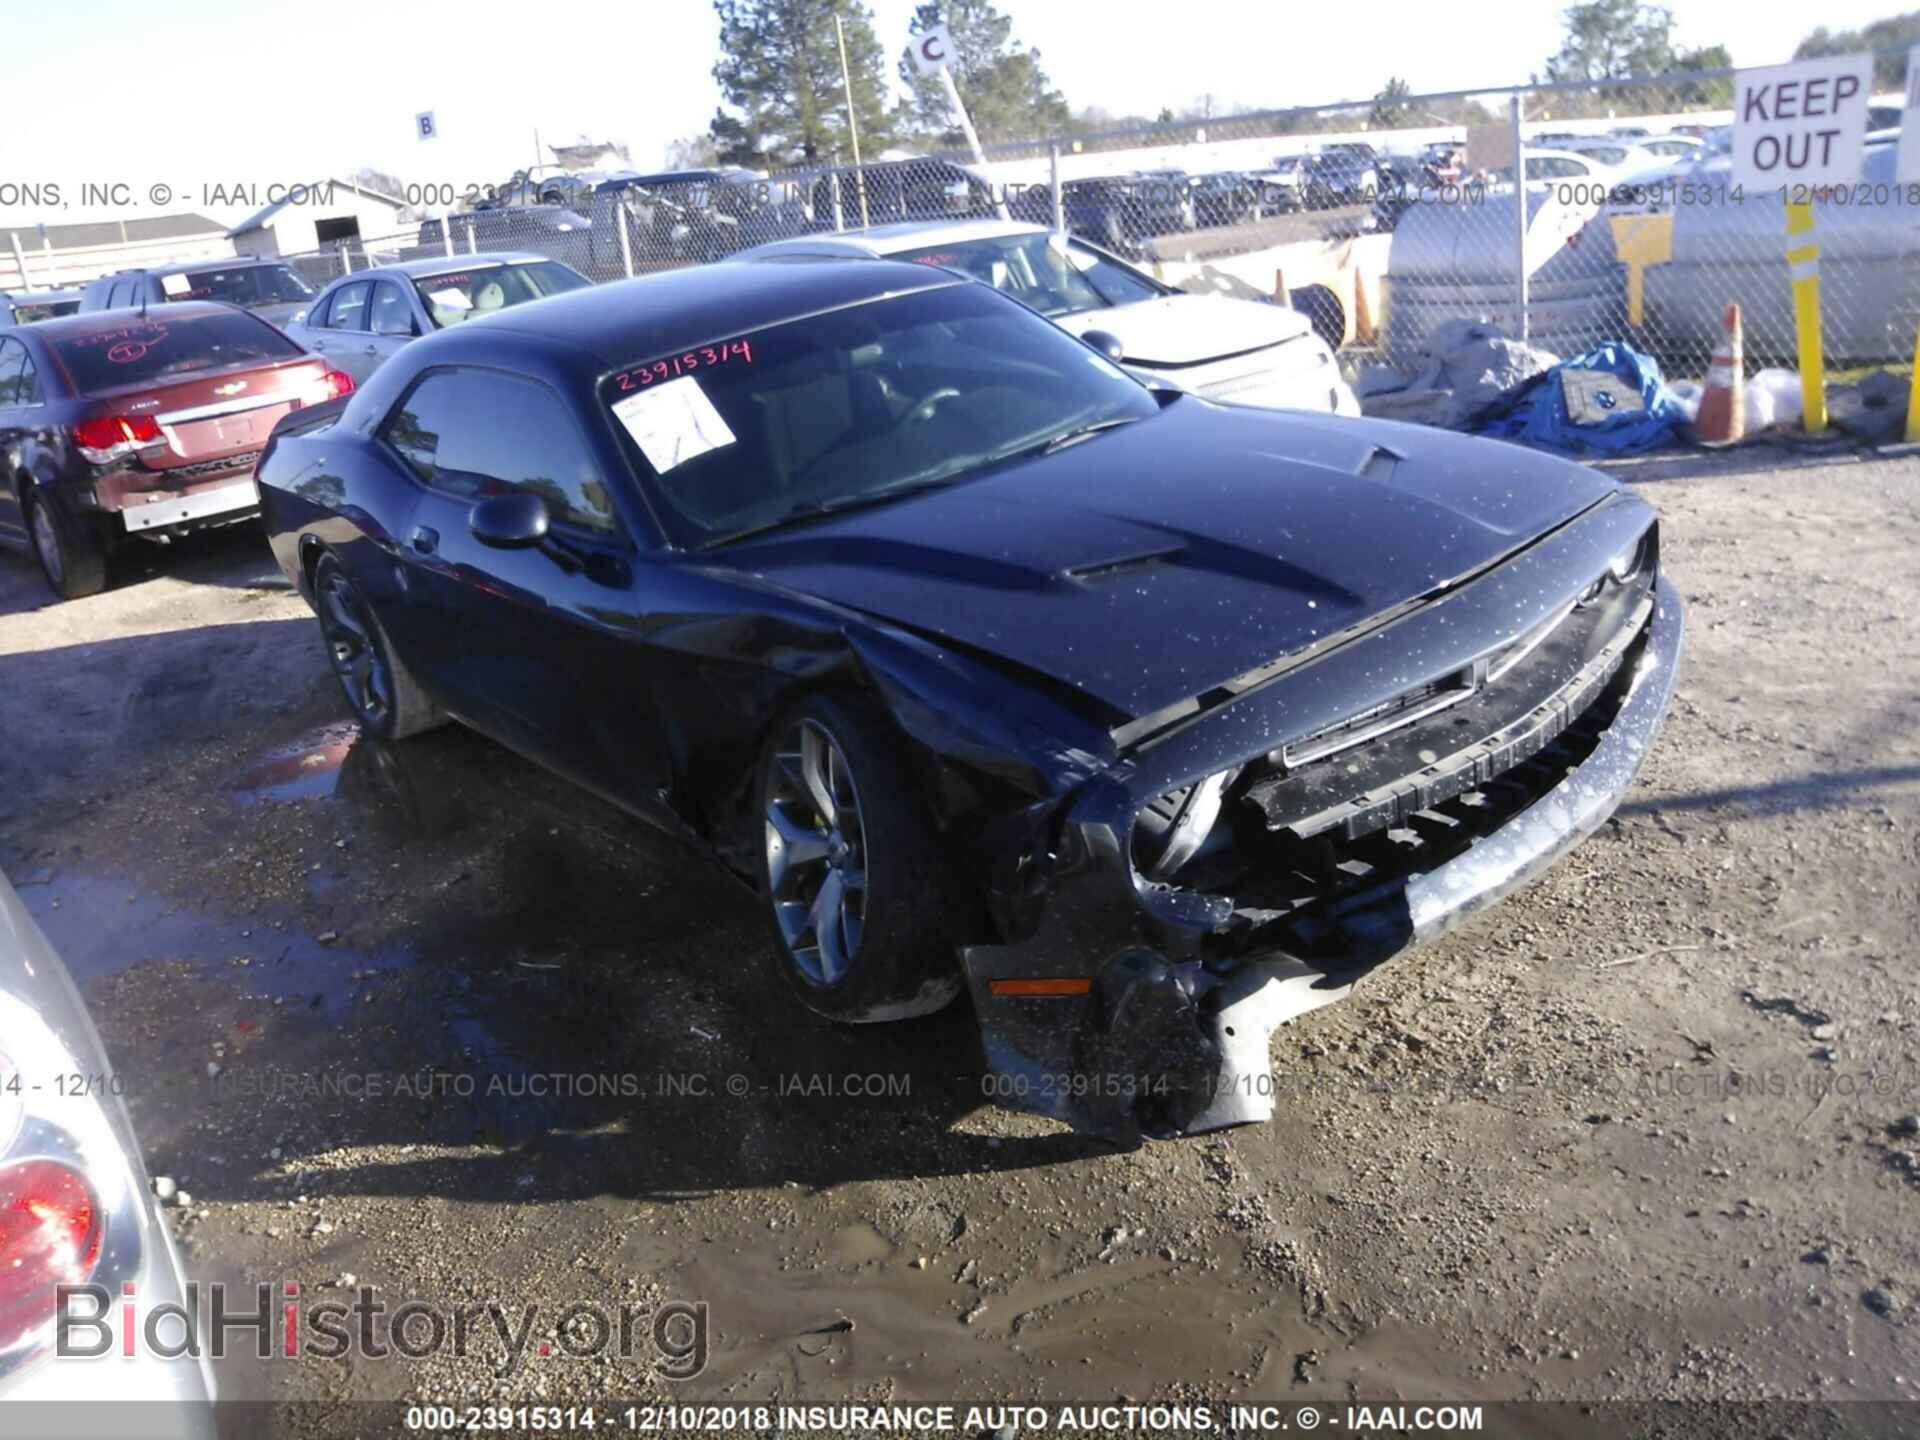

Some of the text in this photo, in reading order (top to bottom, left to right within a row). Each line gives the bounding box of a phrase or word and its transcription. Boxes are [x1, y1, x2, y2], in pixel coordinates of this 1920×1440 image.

[922, 36, 945, 62] C
[1744, 75, 1860, 123] KEEP
[420, 116, 433, 135] B
[1753, 130, 1841, 171] OUT
[616, 340, 752, 390] 23915314
